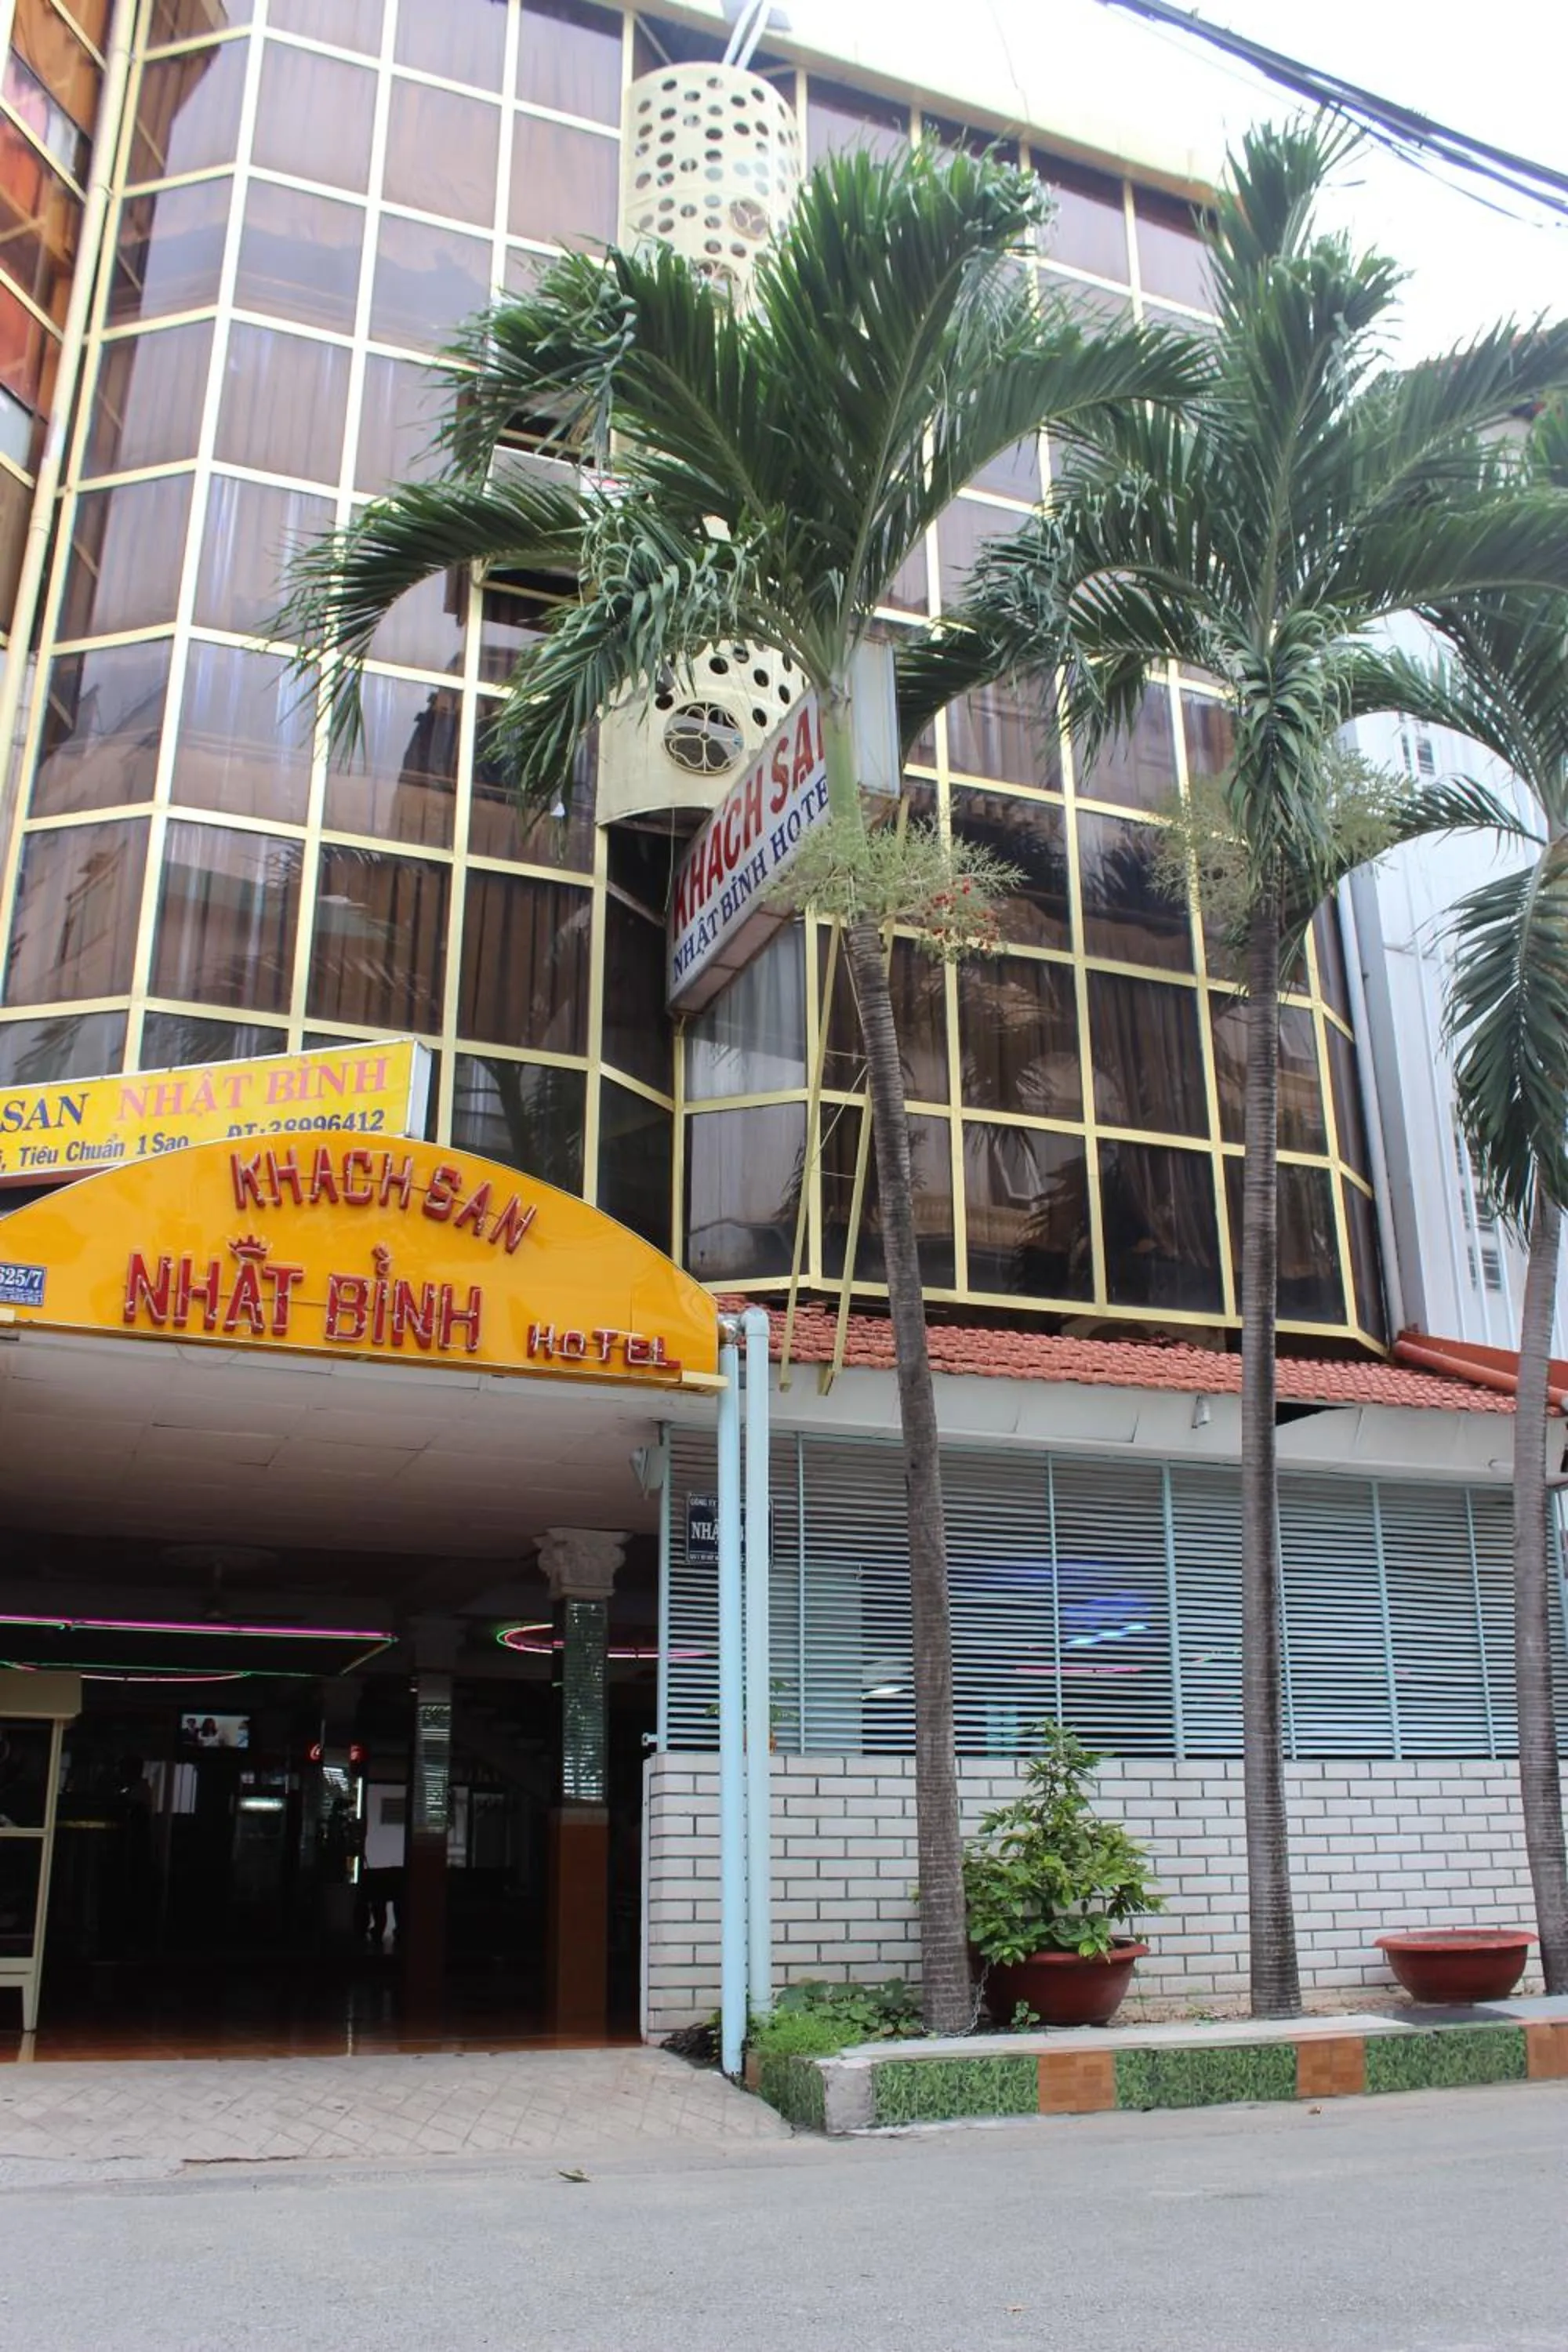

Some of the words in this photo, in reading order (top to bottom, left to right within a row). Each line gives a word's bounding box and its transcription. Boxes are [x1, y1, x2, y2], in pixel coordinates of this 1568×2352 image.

[673, 764, 764, 943] KHÁCH
[770, 775, 829, 866] HOTE
[116, 1069, 252, 1121] NHẬT
[265, 1055, 392, 1105] BÌNH
[19, 1145, 59, 1167] Tiêu
[66, 1132, 125, 1162] Chuẩn
[136, 1134, 147, 1155] 1
[527, 1321, 681, 1369] HOTEL
